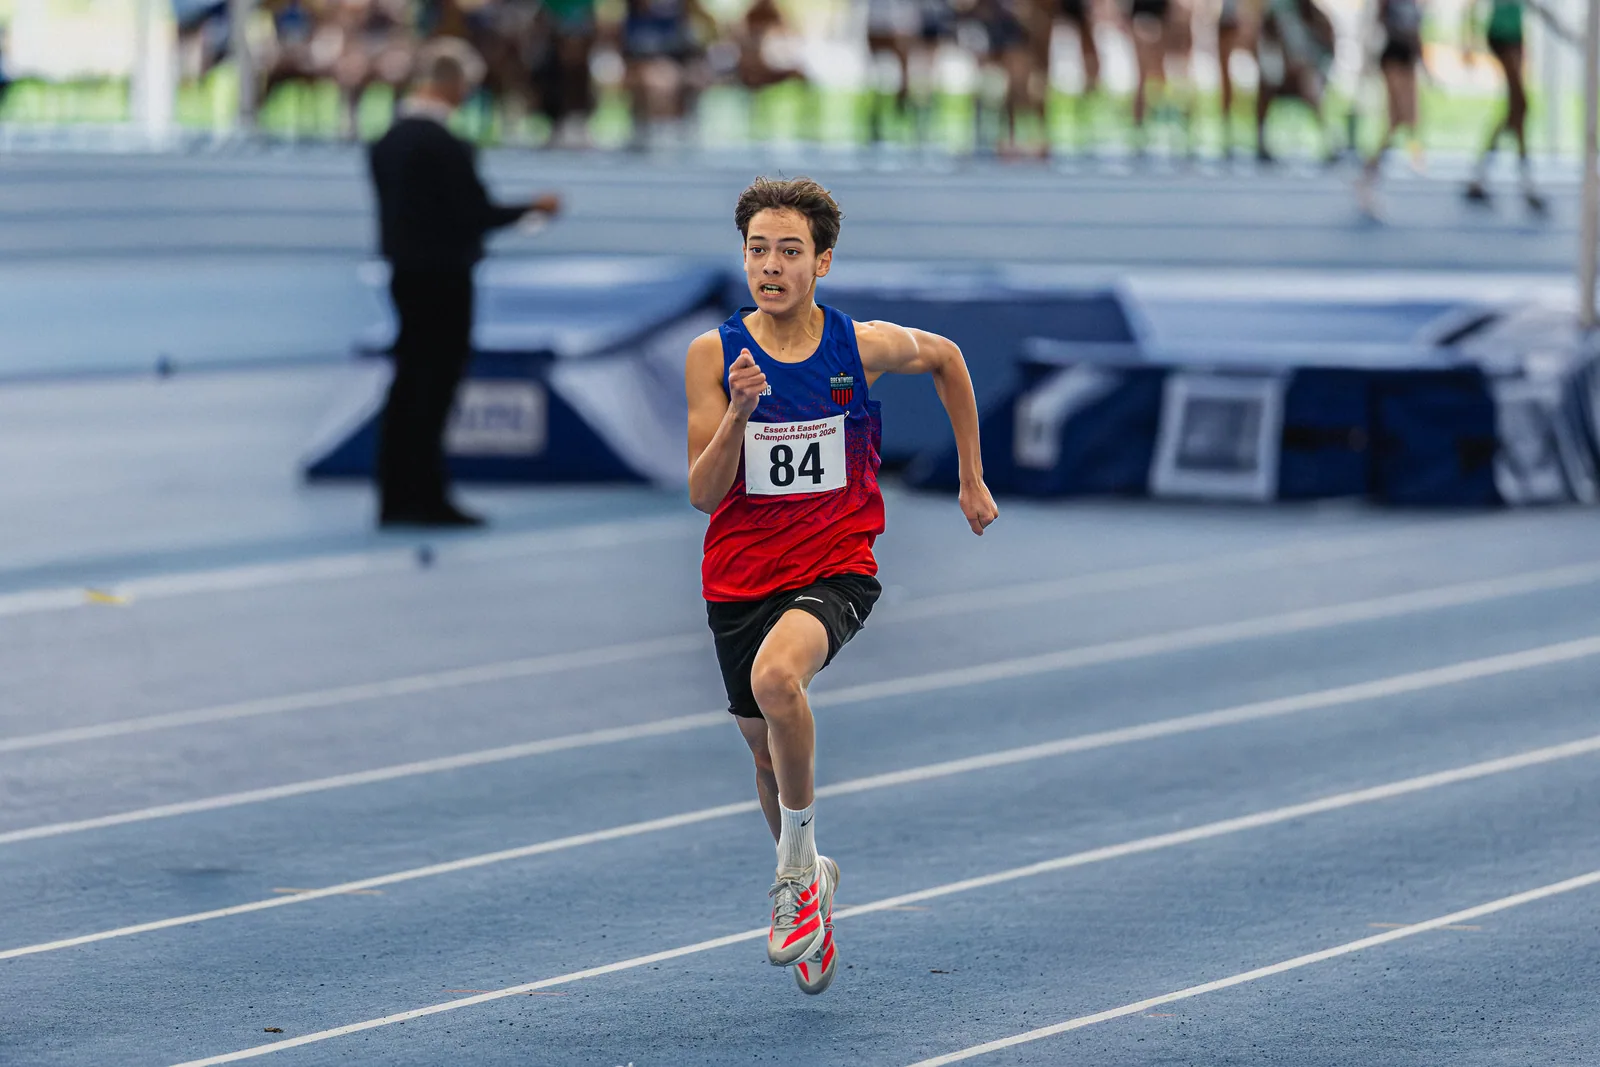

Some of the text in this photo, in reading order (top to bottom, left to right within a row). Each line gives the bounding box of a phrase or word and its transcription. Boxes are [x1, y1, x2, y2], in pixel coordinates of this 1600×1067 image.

[754, 427, 837, 442] Championships 2026
[797, 422, 827, 432] Eastern
[769, 441, 825, 487] 84
